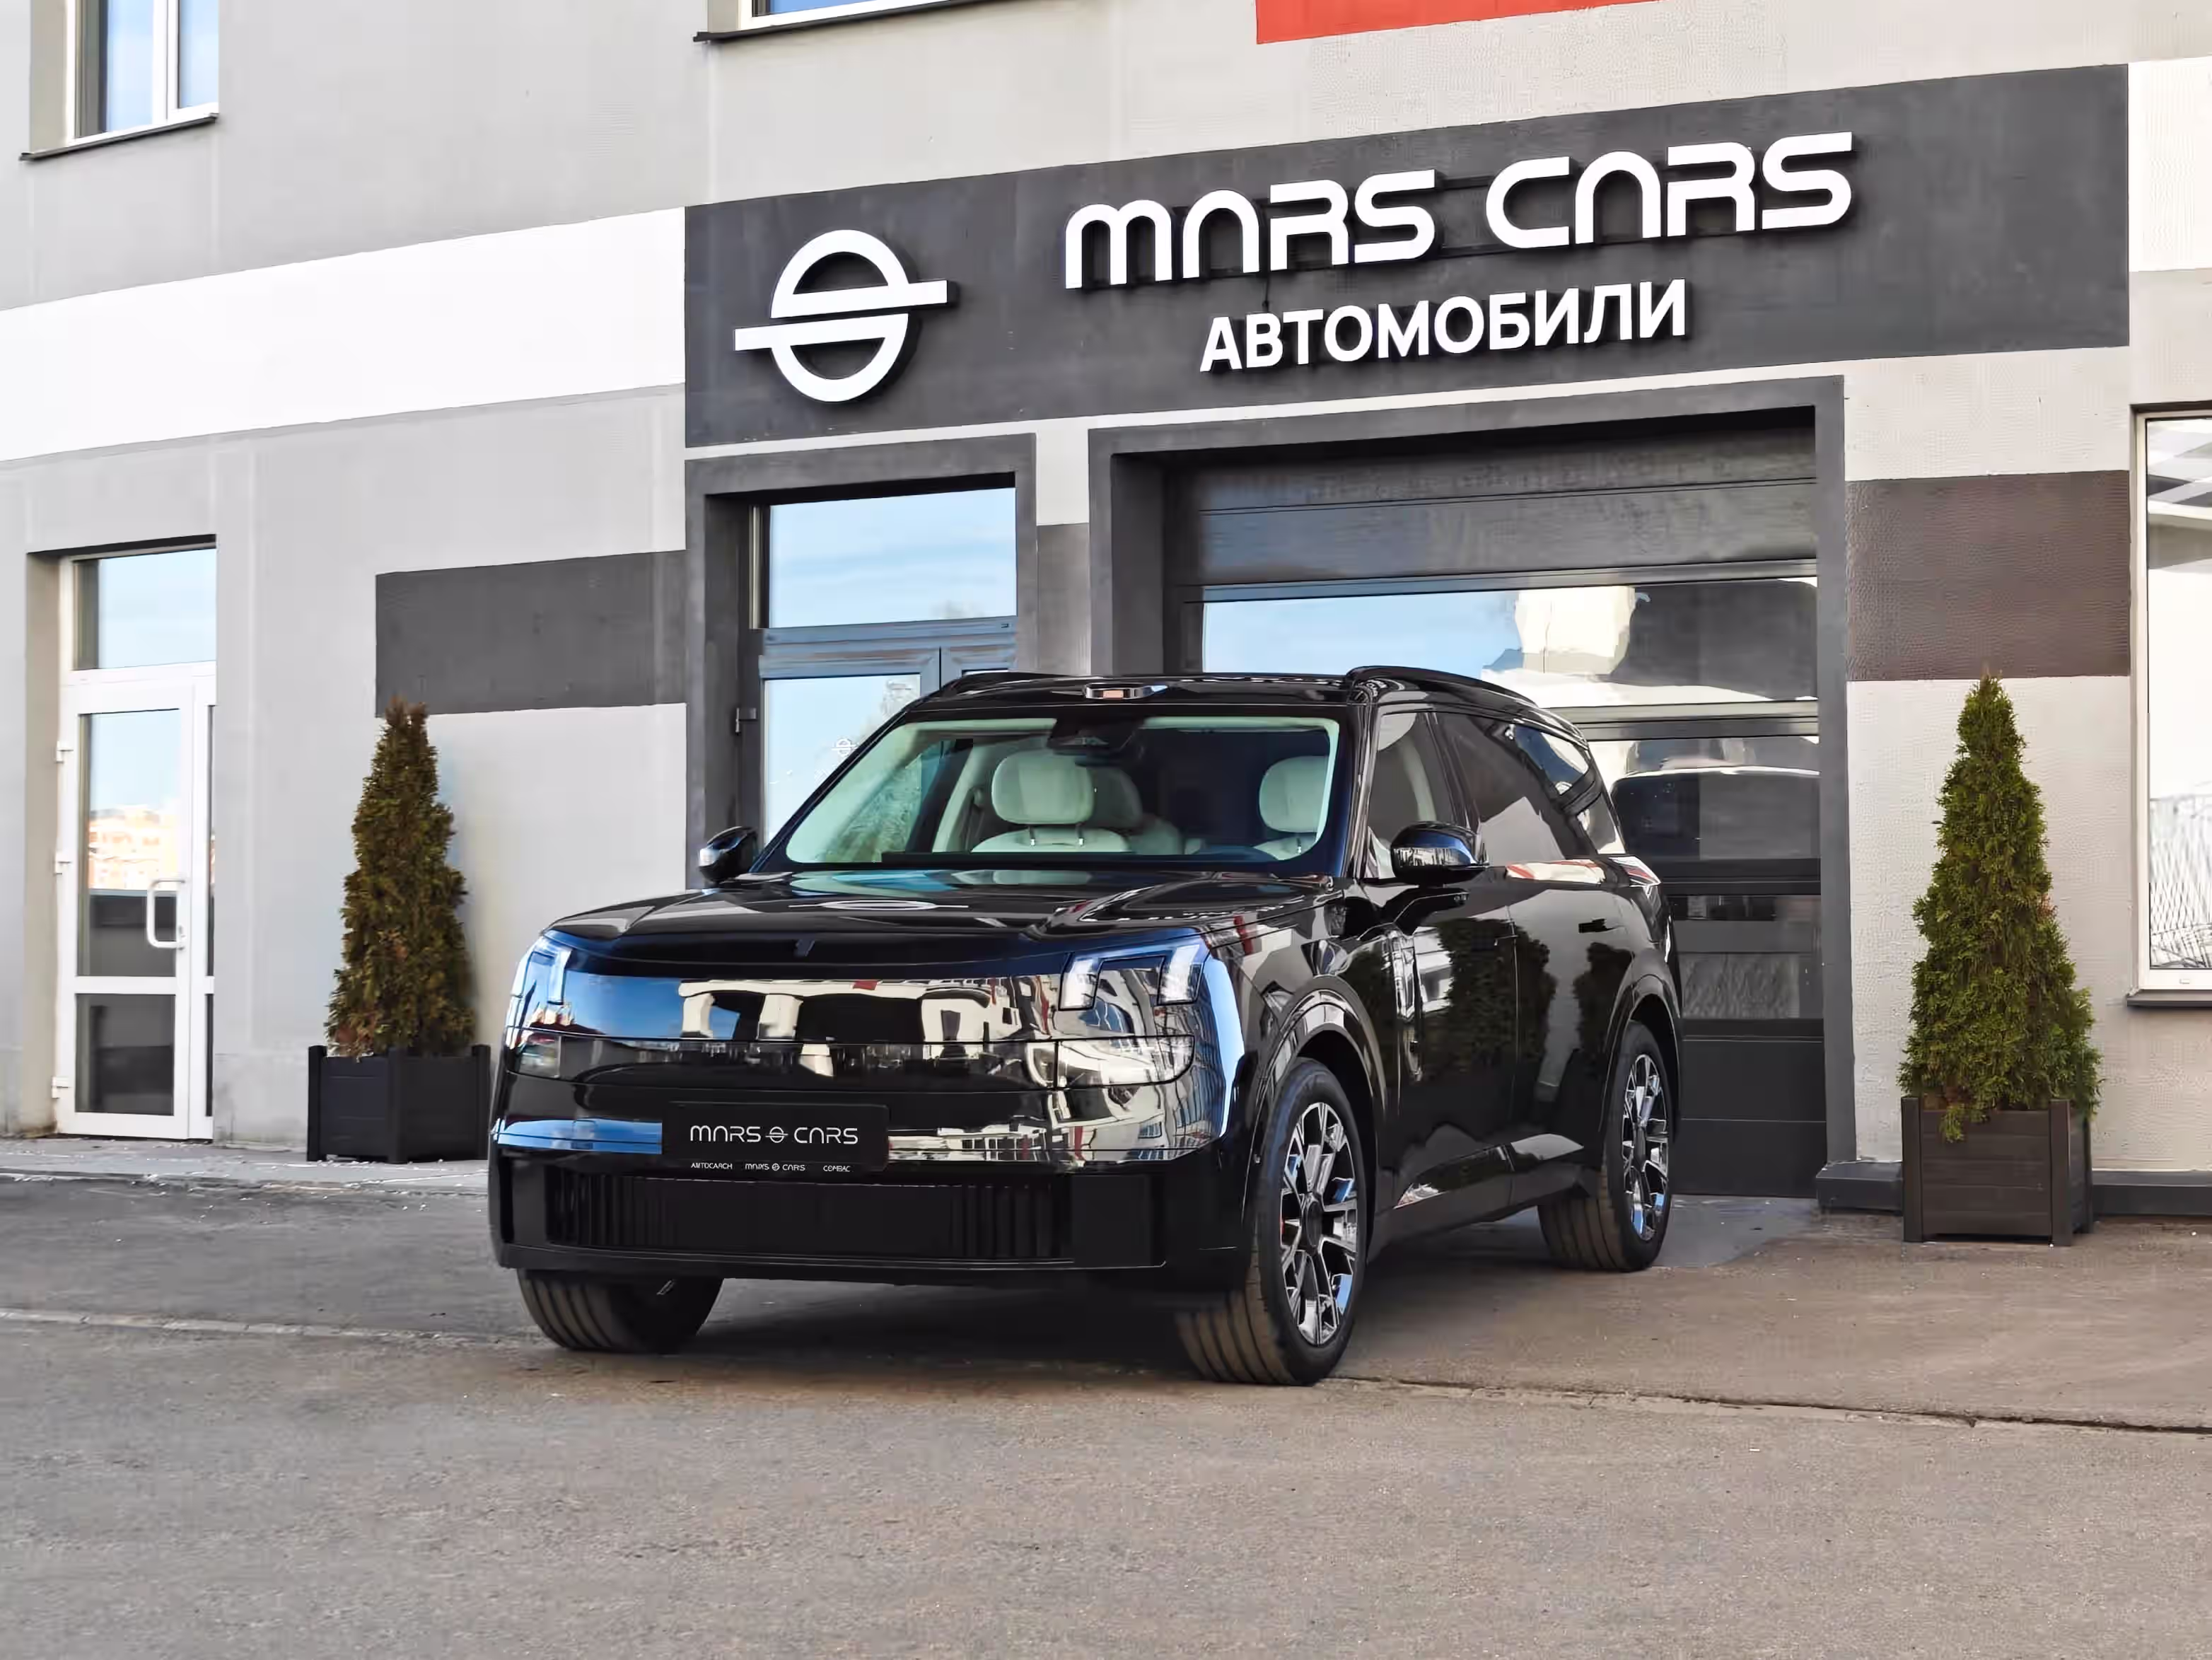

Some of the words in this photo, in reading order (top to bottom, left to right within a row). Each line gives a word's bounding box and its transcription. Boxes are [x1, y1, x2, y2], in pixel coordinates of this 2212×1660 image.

[1066, 169, 1435, 289] MARS
[1486, 132, 1852, 248] CARS
[1200, 279, 1685, 371] АВТОМОБИЛИ
[690, 1125, 762, 1143] MARS
[794, 1126, 858, 1145] CARS
